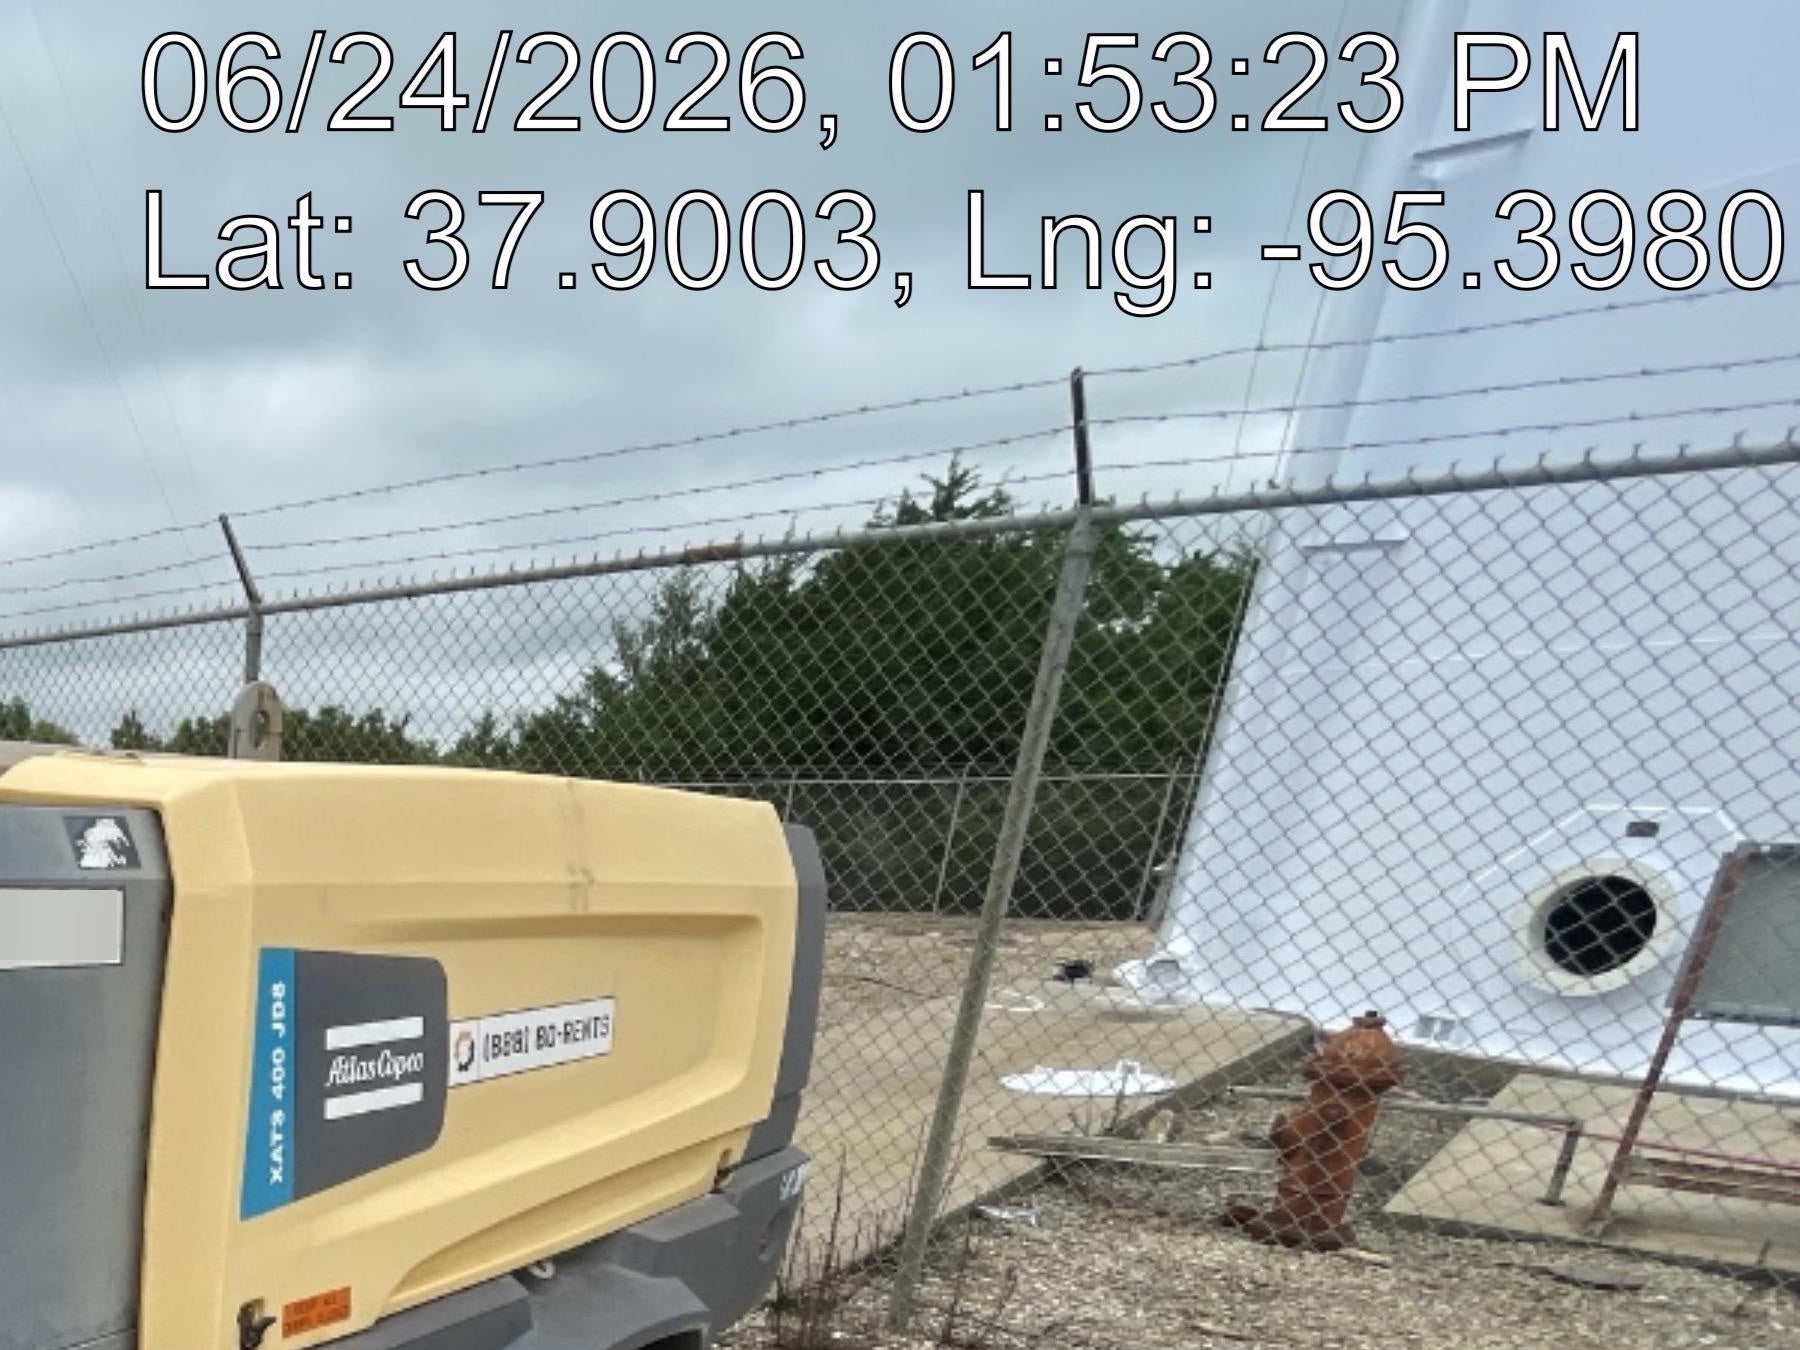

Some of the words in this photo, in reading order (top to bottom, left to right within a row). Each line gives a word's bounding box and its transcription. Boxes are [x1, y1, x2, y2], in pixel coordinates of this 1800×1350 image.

[271, 1045, 287, 1101] 400
[324, 1054, 376, 1088] Atlas
[377, 1049, 424, 1081] Copco
[269, 1107, 287, 1187] XATS
